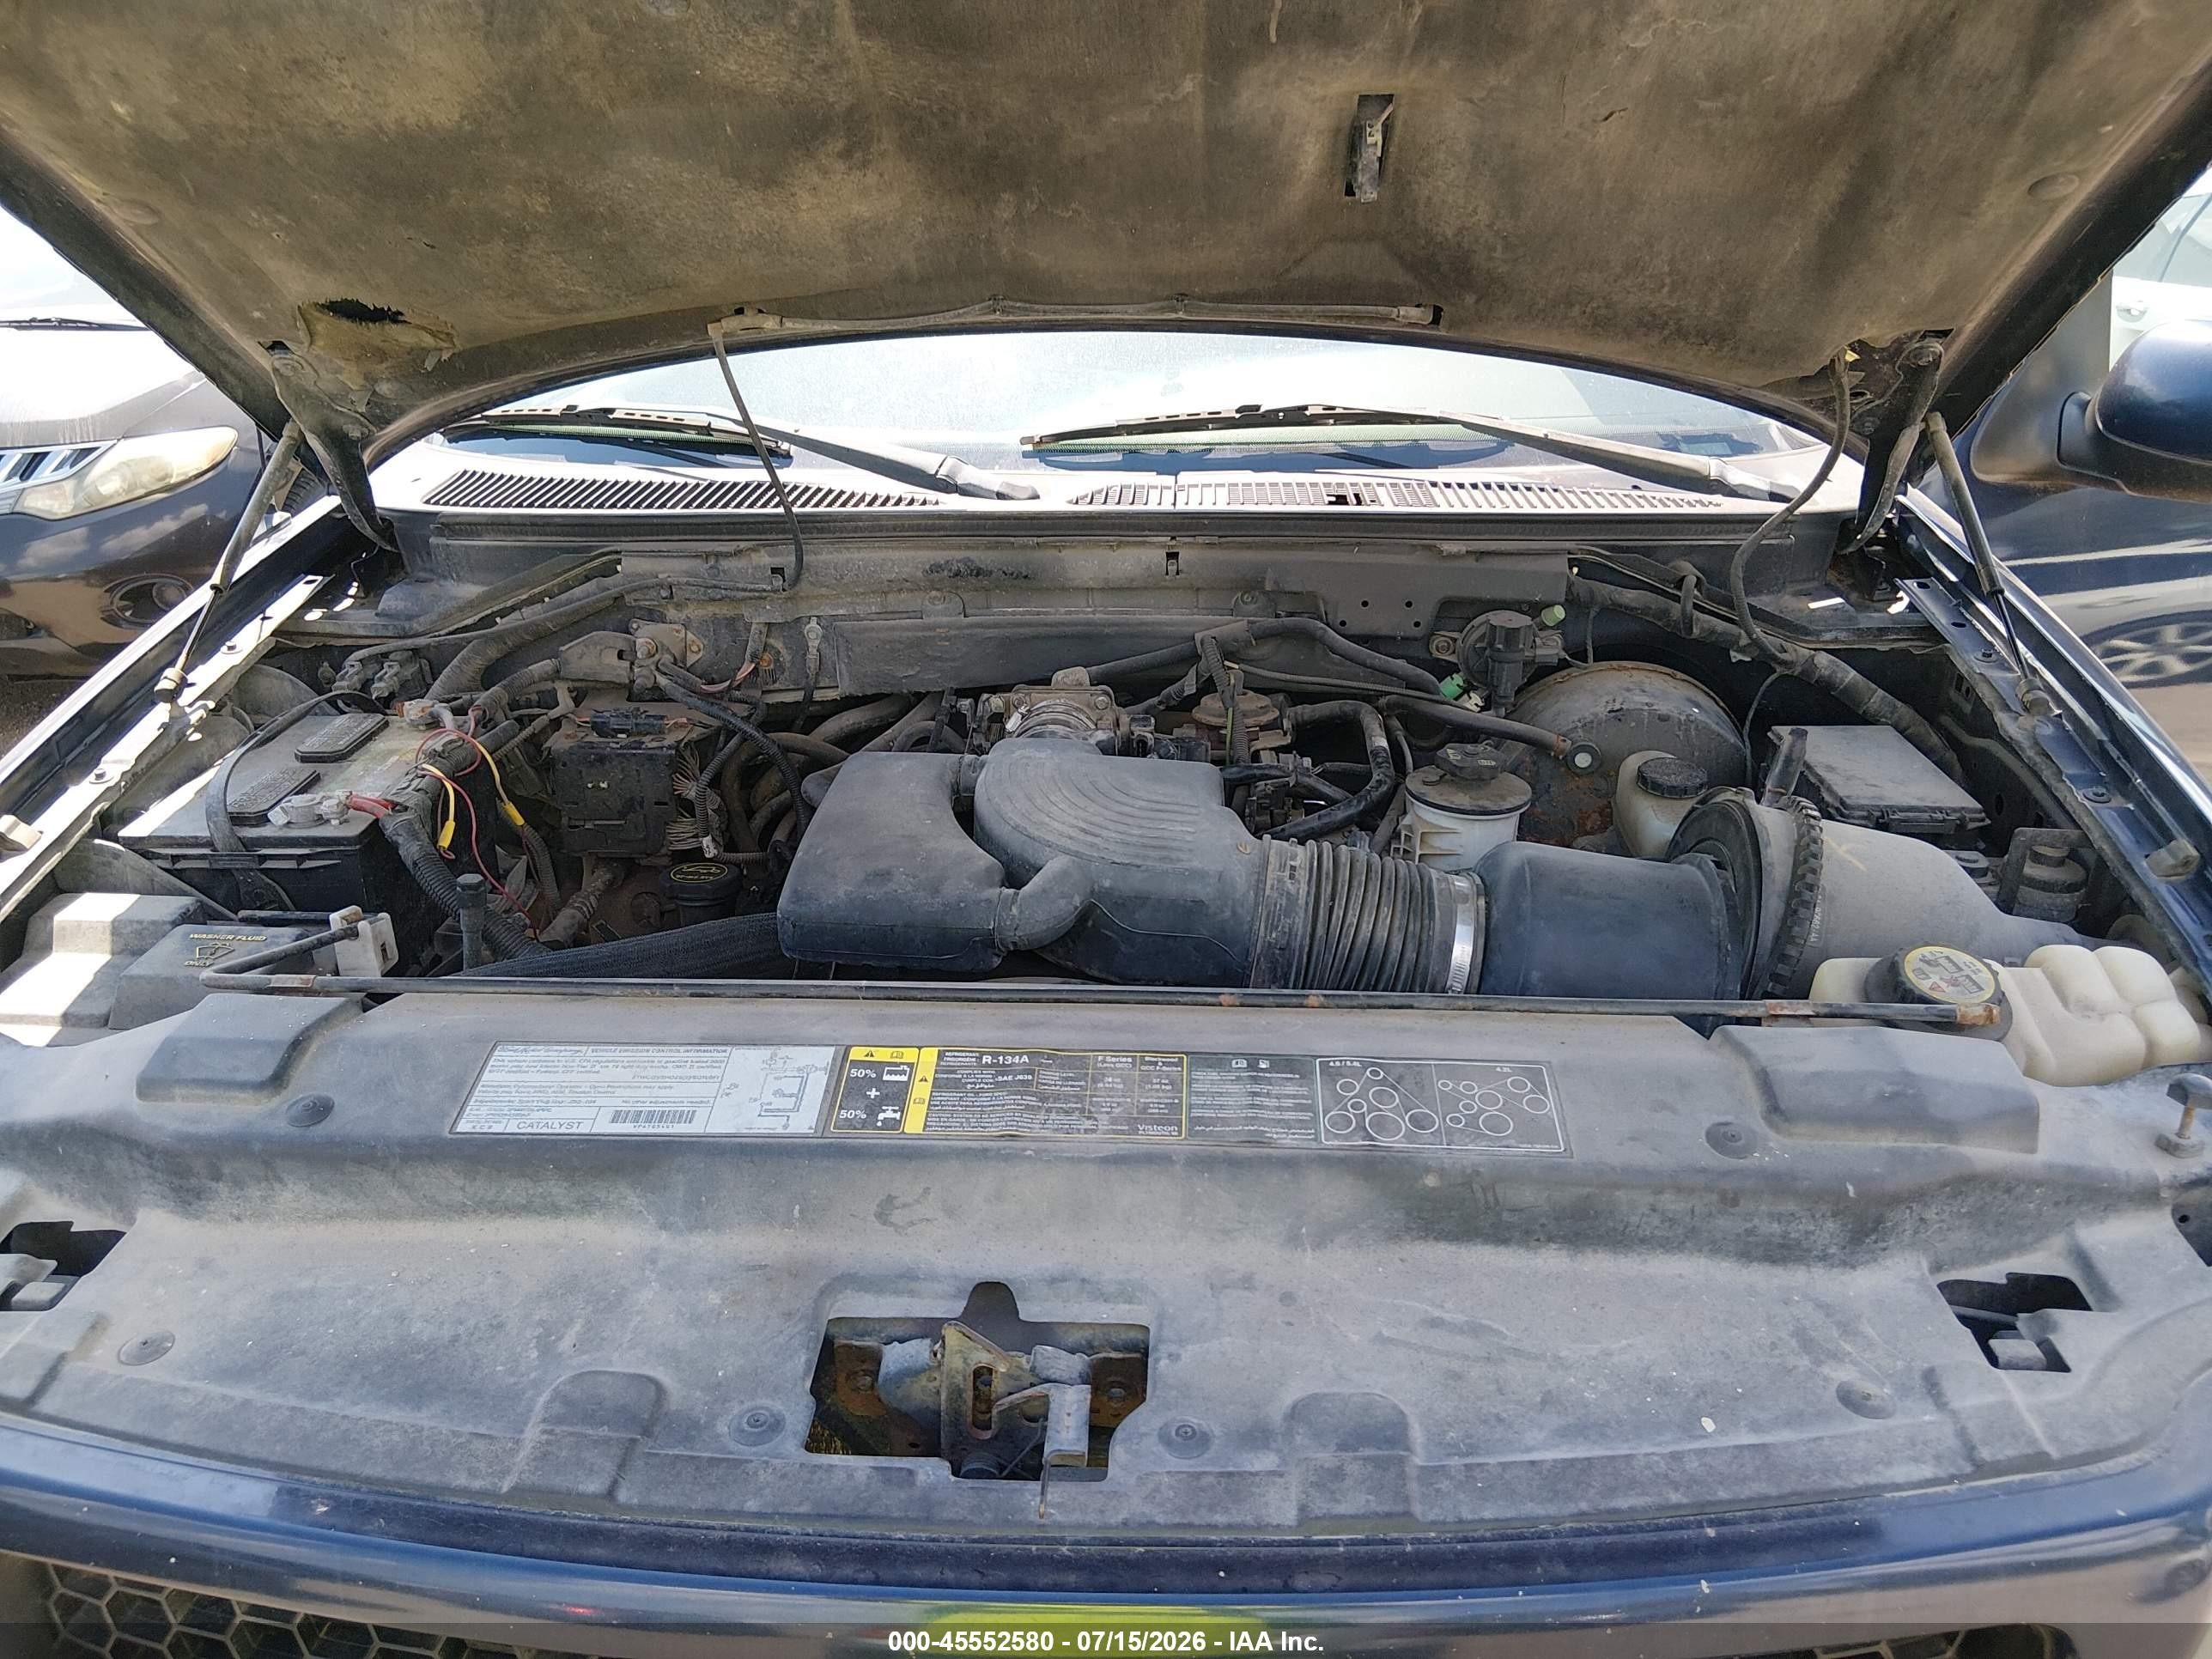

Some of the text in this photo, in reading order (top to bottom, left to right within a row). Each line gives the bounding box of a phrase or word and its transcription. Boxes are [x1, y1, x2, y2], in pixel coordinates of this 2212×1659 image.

[981, 1054, 1030, 1065] R-134A
[849, 1068, 877, 1078] 50%
[839, 1109, 867, 1119] 50%
[517, 1121, 584, 1130] CATALYST
